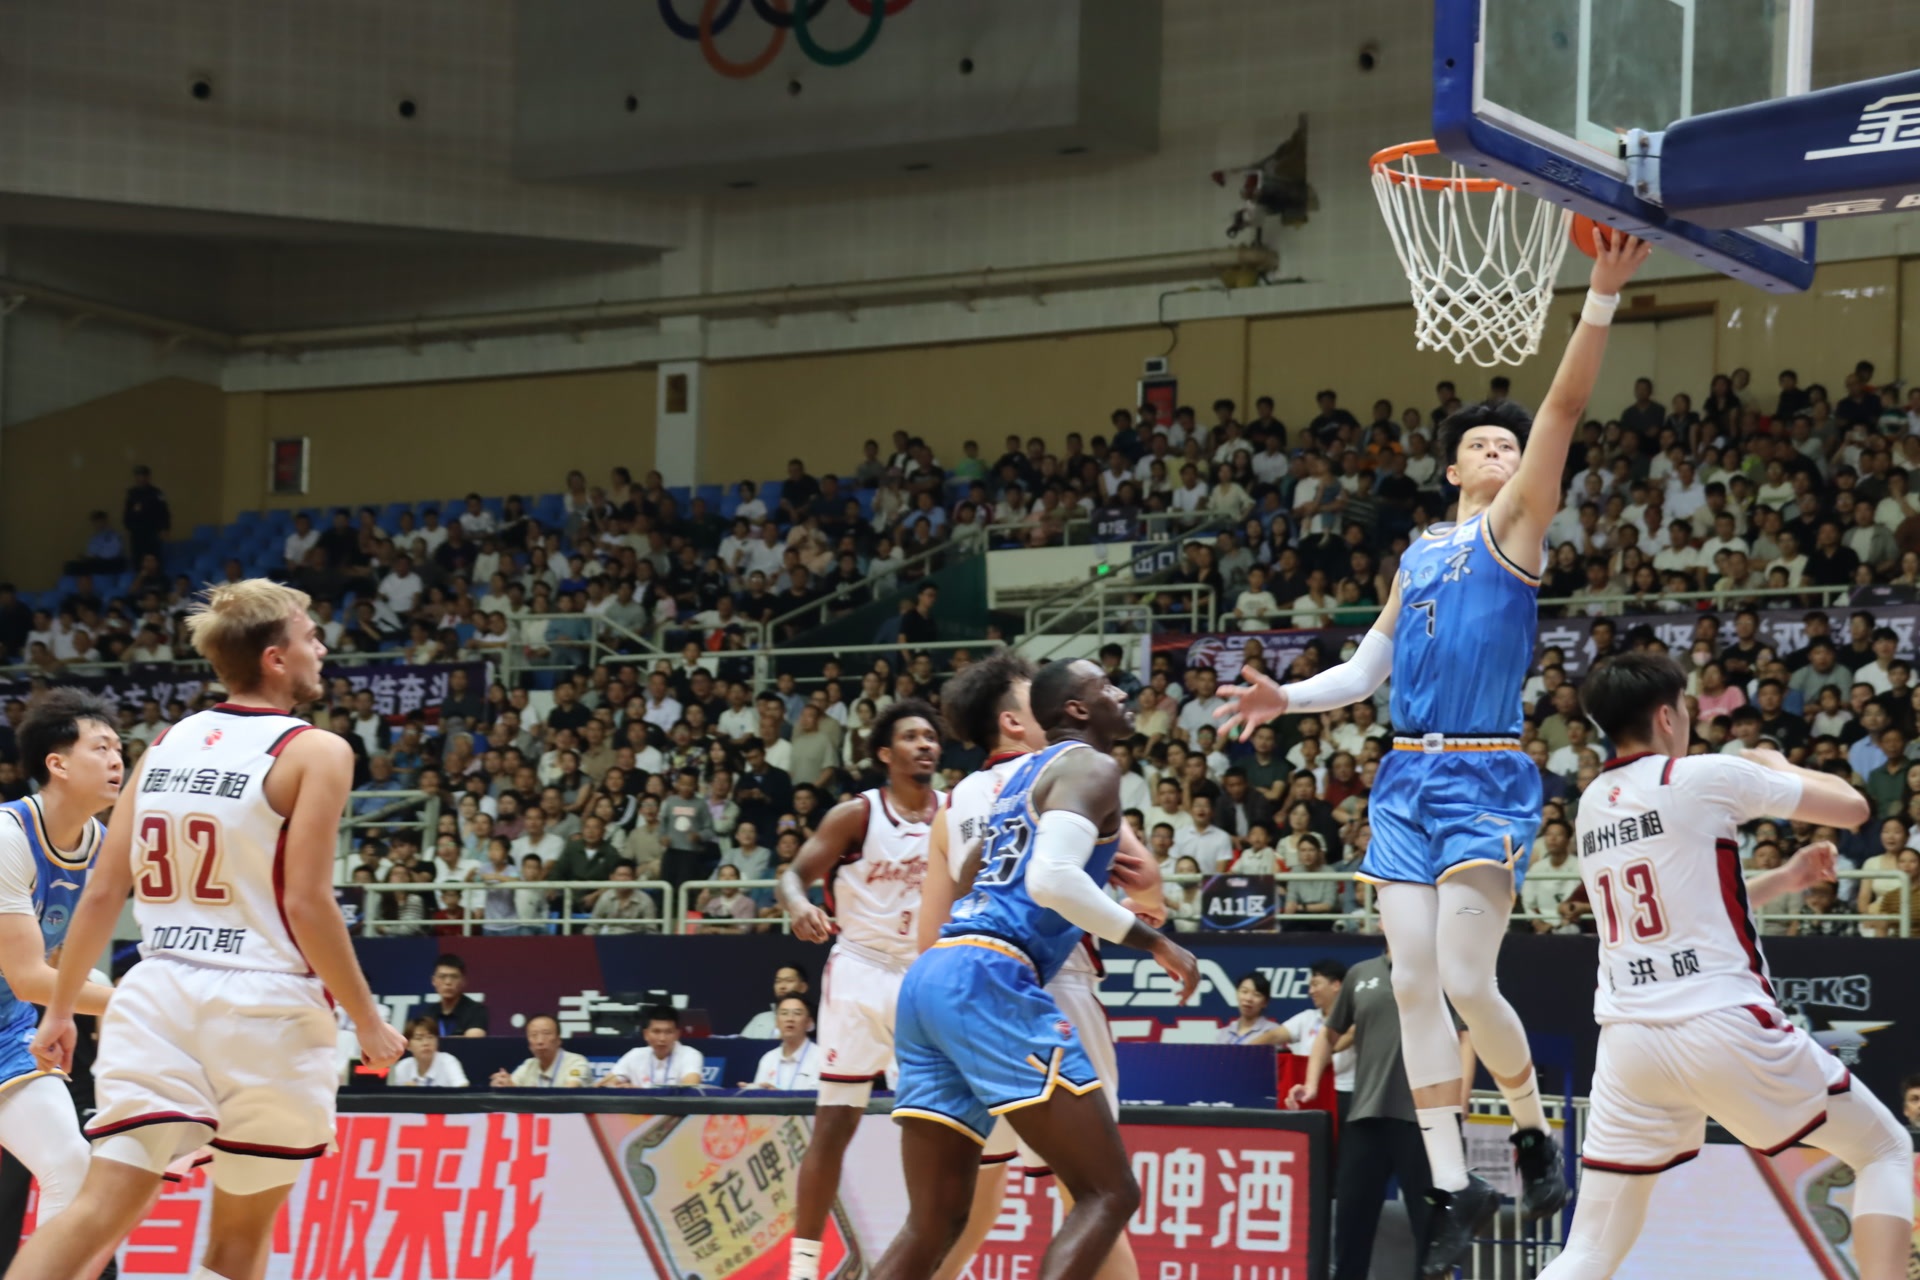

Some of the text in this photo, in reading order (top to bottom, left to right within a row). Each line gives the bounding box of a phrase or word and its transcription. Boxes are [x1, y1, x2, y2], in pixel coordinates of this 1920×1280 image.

[1408, 599, 1437, 638] 7
[142, 768, 250, 799] 稠州金租
[134, 810, 233, 906] 32
[1208, 895, 1267, 917] A11区
[1594, 857, 1669, 950] 13
[151, 926, 247, 955] 加尔斯
[1609, 948, 1700, 994] 洪硕
[985, 1147, 1295, 1252] 啤酒
